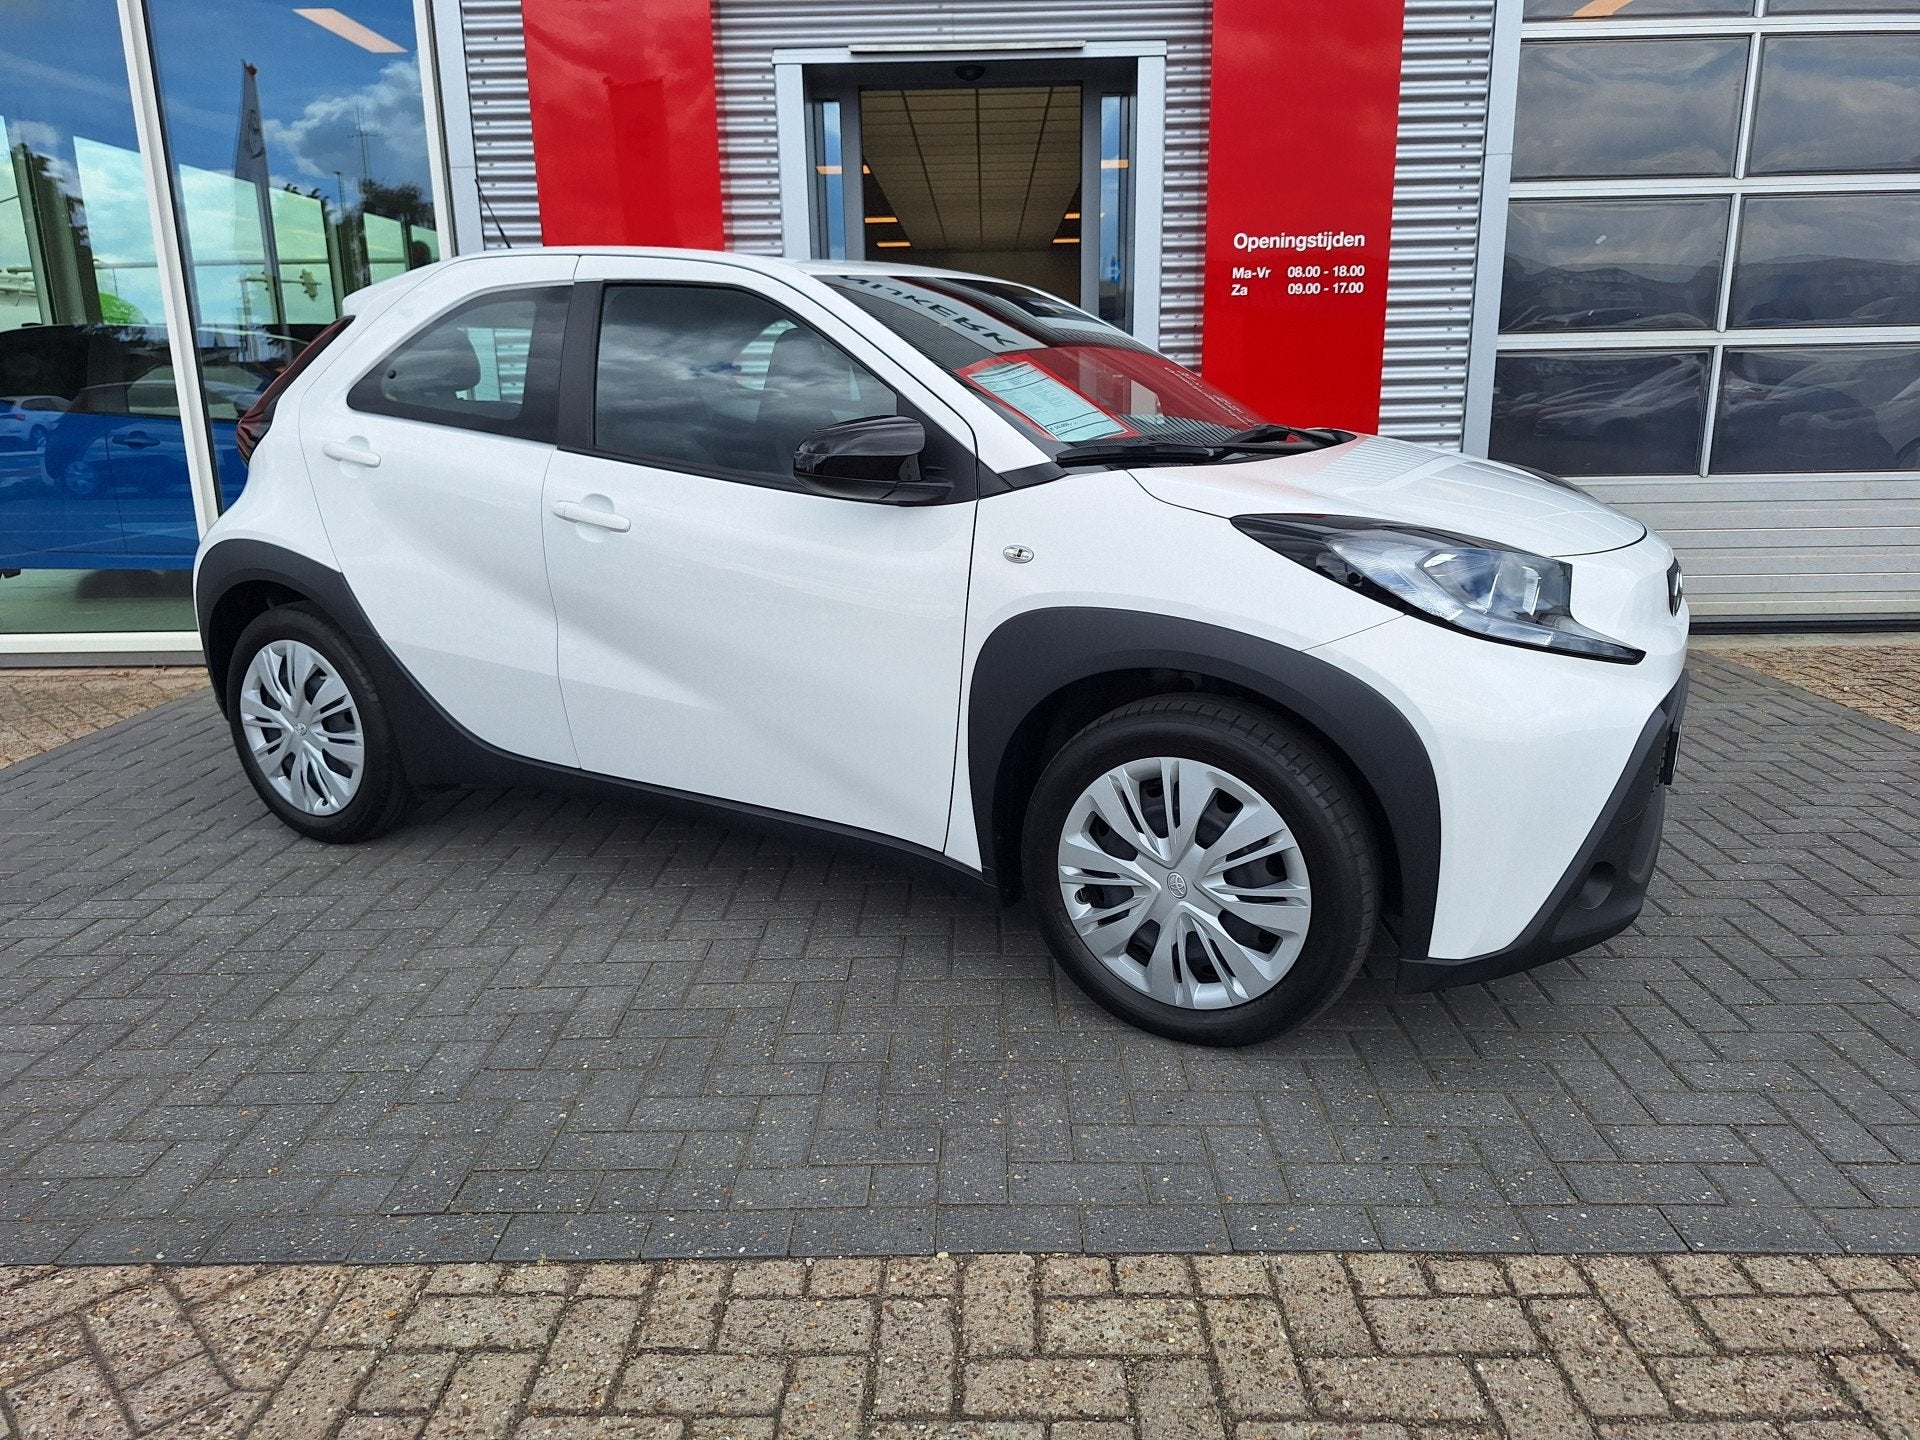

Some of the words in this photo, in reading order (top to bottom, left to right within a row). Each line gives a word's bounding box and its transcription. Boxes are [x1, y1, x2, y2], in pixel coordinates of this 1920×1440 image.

[1233, 231, 1365, 252] Openingstijden
[1232, 266, 1271, 279] Ma-Vr
[1287, 265, 1321, 278] 08.00
[1332, 264, 1365, 277] 18.00
[1231, 284, 1248, 296] Za
[1287, 282, 1321, 295] 09.00
[1332, 281, 1364, 294] 17.00
